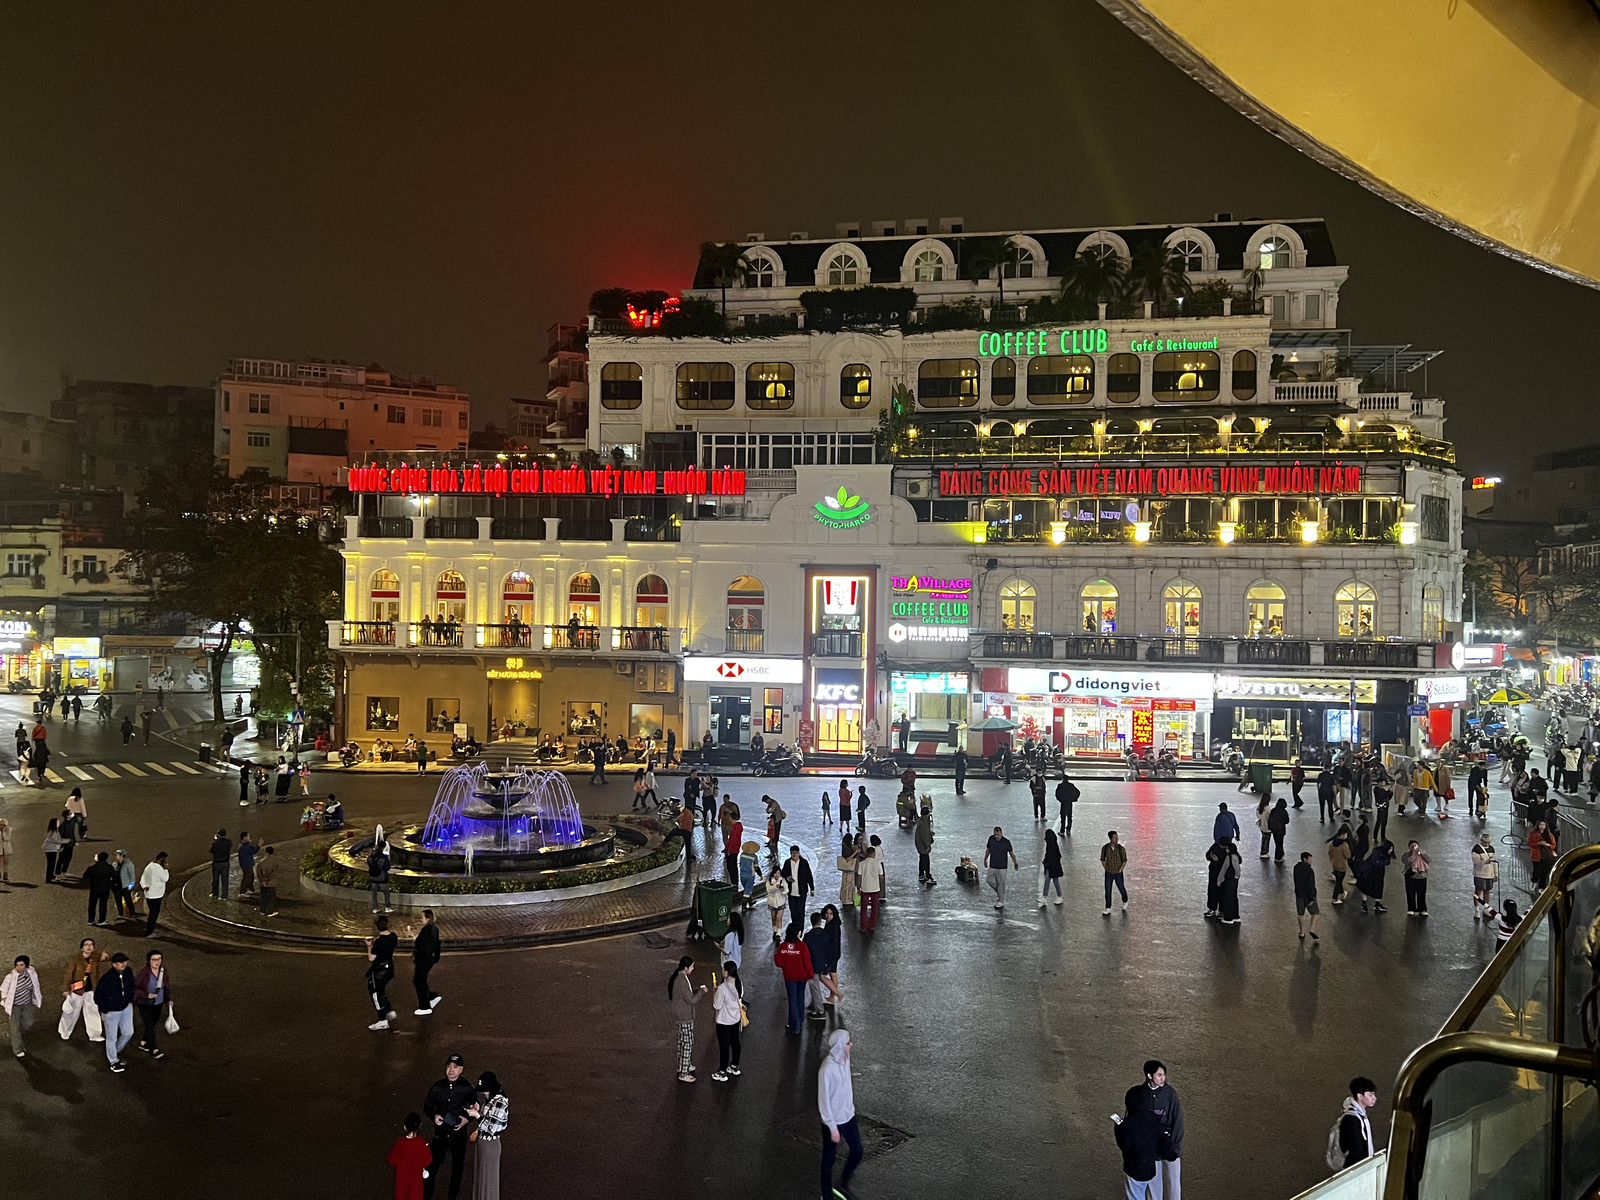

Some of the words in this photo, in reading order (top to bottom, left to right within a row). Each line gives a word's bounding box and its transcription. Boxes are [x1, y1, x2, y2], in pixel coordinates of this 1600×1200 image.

[979, 330, 1048, 356] COFFEE
[1060, 328, 1108, 354] CLUB
[1156, 339, 1164, 351] &
[1166, 337, 1219, 351] Restaurant
[390, 462, 428, 497] CỘNG
[462, 460, 481, 493] XÃ
[484, 463, 508, 498] HỘI
[543, 464, 586, 494] NGHĨA
[590, 464, 622, 499] VIỆT
[623, 469, 657, 495] NAM
[663, 464, 707, 495] MUÔN
[711, 464, 745, 495] NĂM
[940, 462, 982, 495] ĐẢNG
[988, 463, 1031, 499] CỘNG
[1038, 461, 1071, 494] SẢN
[1075, 462, 1110, 499] VIỆT
[1115, 468, 1152, 494] NAM
[1157, 467, 1213, 496] QUANG
[1220, 467, 1259, 493] VINH
[1264, 460, 1314, 493] MUÔN
[1319, 460, 1360, 493] NĂM
[813, 513, 871, 529] PHYTOPHARCO
[892, 602, 935, 616] COFFEE
[940, 602, 969, 617] CLUB
[746, 667, 770, 675] HSBC
[816, 684, 860, 700] KFC
[1075, 677, 1161, 693] didongviet
[1240, 683, 1300, 695] VERTU
